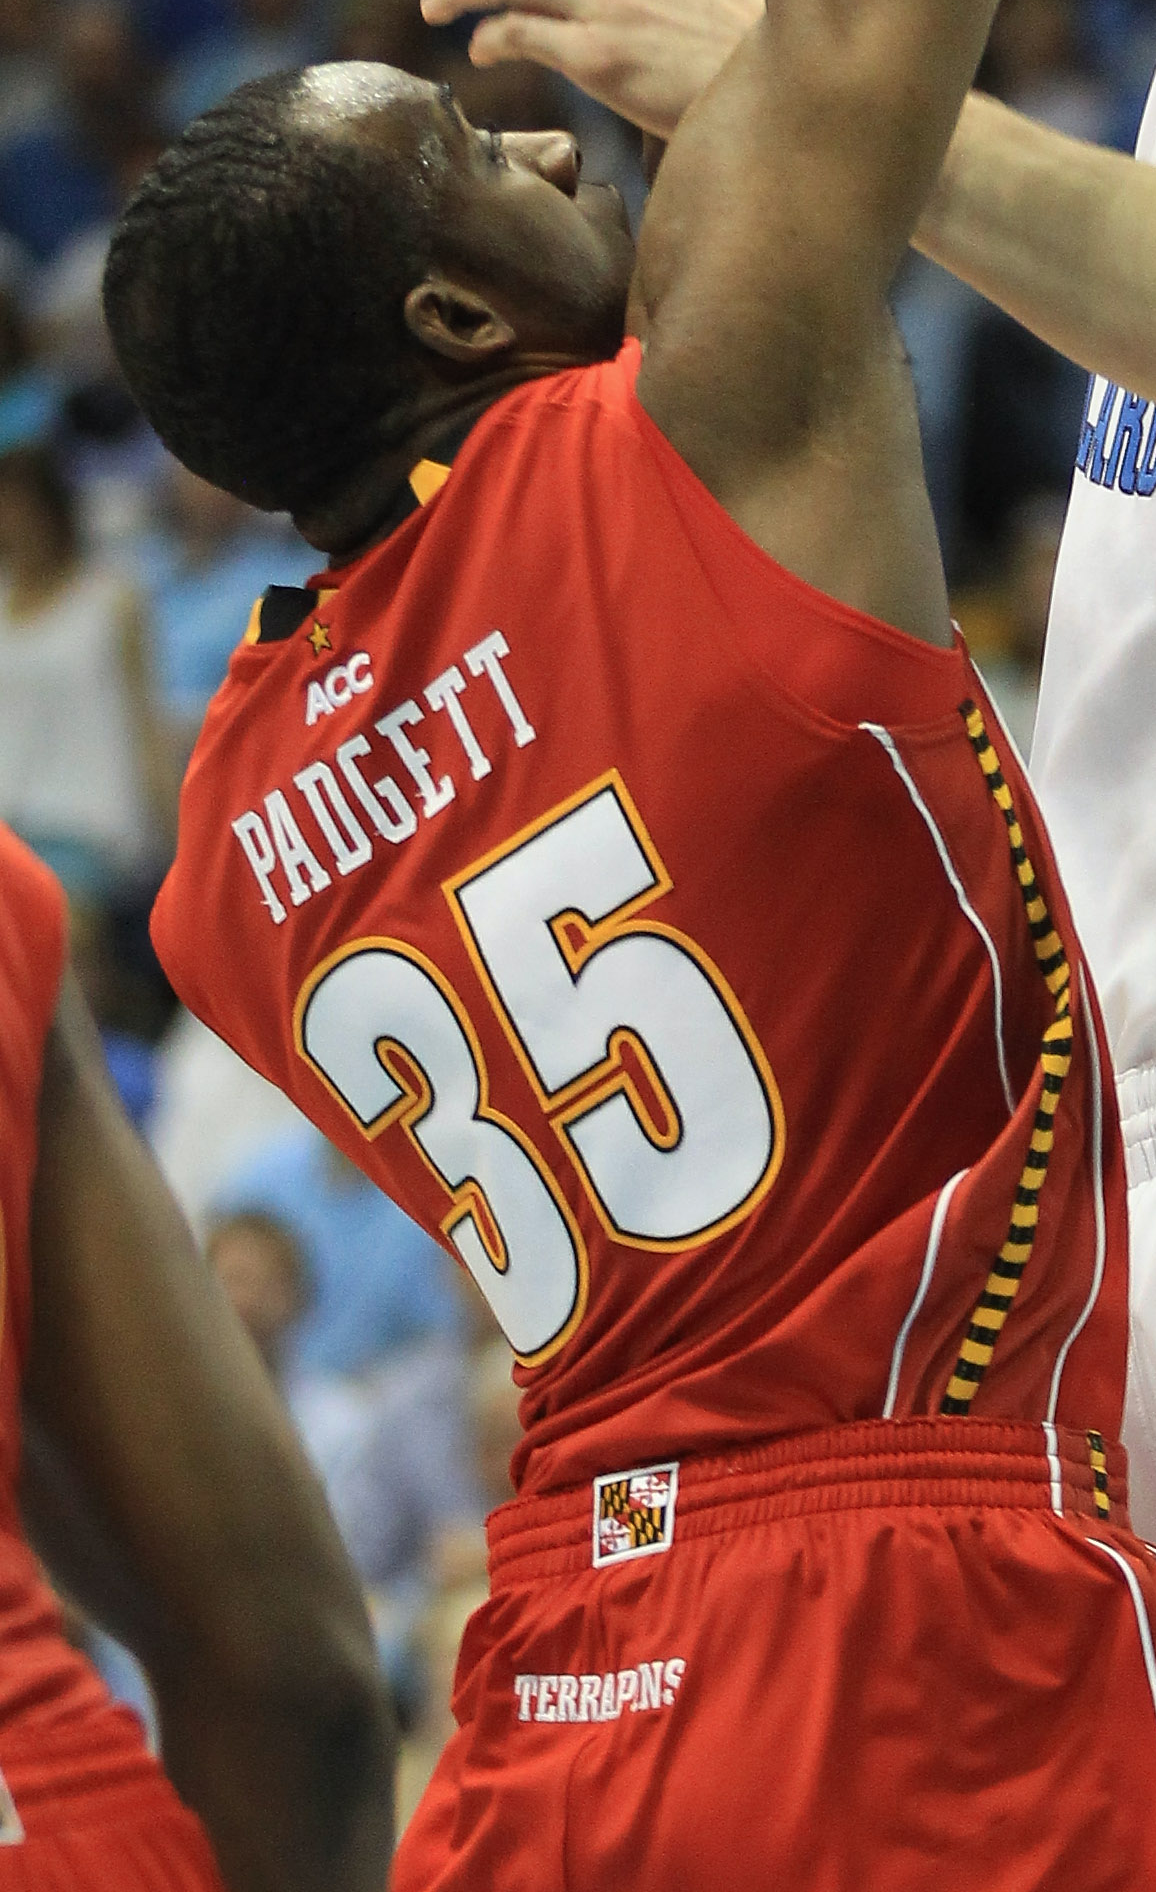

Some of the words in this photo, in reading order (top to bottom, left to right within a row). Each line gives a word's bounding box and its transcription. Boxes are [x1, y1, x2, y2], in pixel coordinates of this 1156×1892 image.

[231, 630, 536, 924] PADGETT
[305, 651, 374, 726] ACC
[293, 767, 786, 1368] 35
[514, 1657, 687, 1723] TERRAPNS
